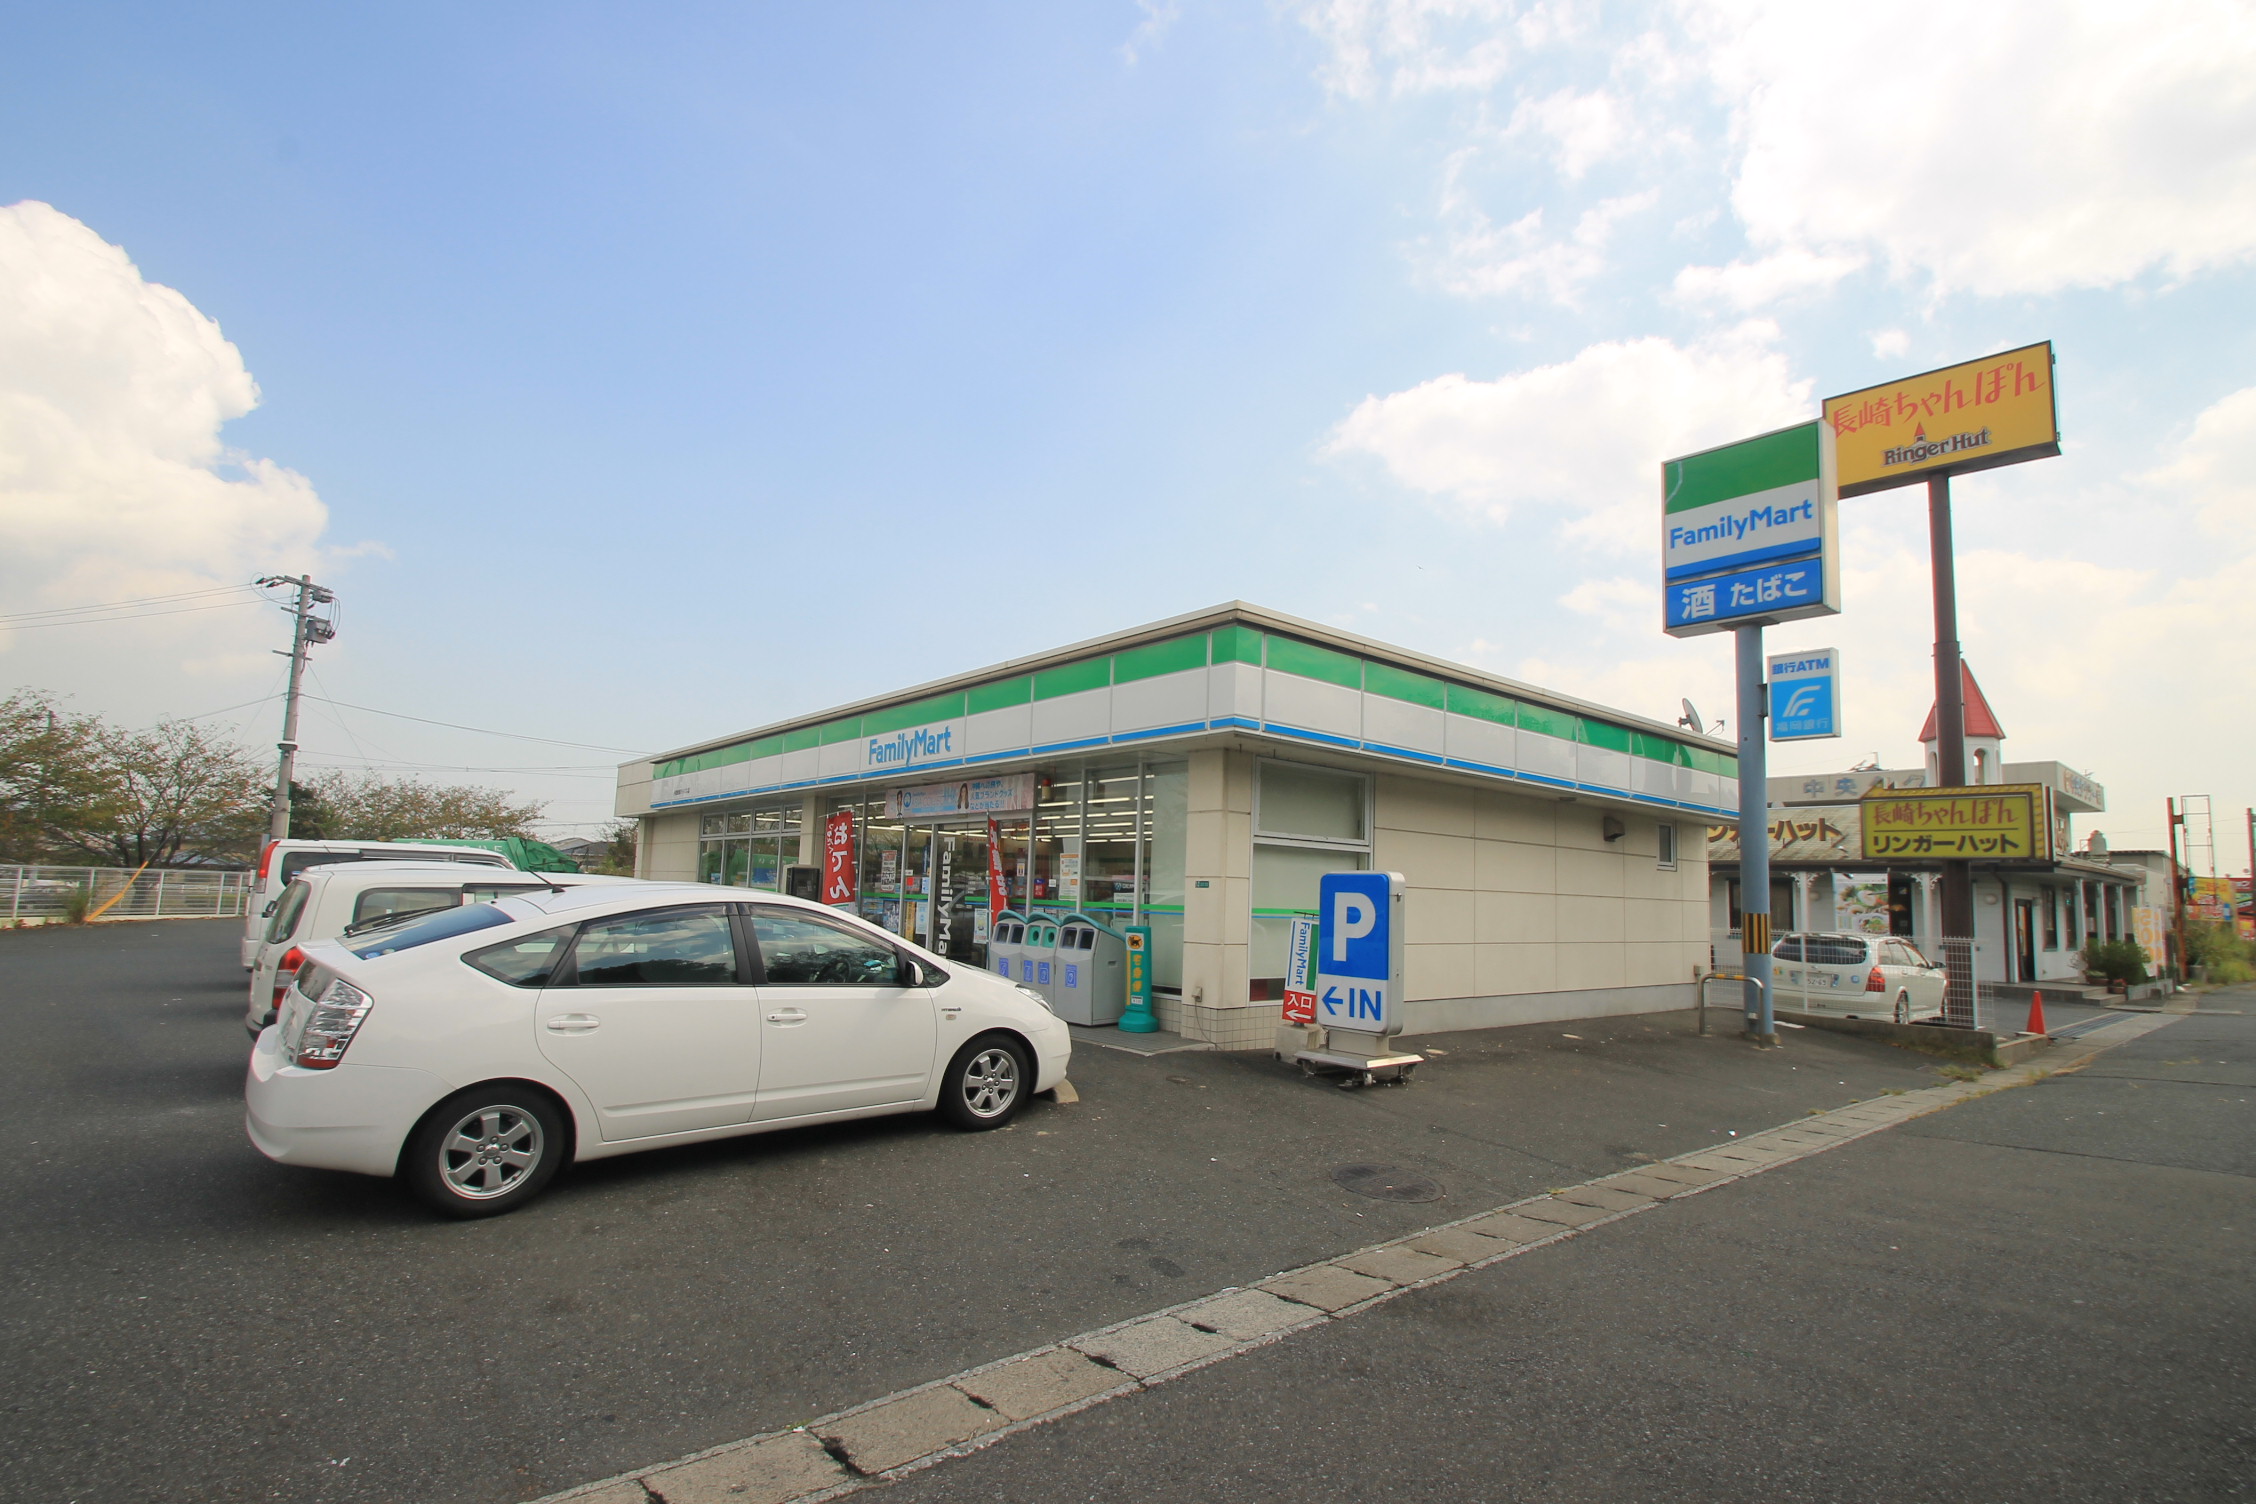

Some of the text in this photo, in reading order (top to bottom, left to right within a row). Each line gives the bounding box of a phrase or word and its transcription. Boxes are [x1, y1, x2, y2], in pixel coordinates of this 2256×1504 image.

[1833, 361, 2046, 438] 長崎ちゃんぽん
[1882, 428, 1990, 467] Ringer Hut
[1669, 499, 1813, 550] FamilyMart
[1681, 571, 1808, 619] 酒 たばこ
[1772, 657, 1830, 675] 銀行ATM
[868, 725, 952, 767] FamilyMart
[1874, 798, 2019, 826] 長崎ちゃんぽん
[1873, 833, 2020, 853] リンガーハット
[937, 836, 956, 959] FamilyMa
[1332, 891, 1377, 963] P
[1295, 921, 1311, 986] FamilyMart
[1287, 993, 1313, 1010] 入口
[1349, 987, 1382, 1021] IN
